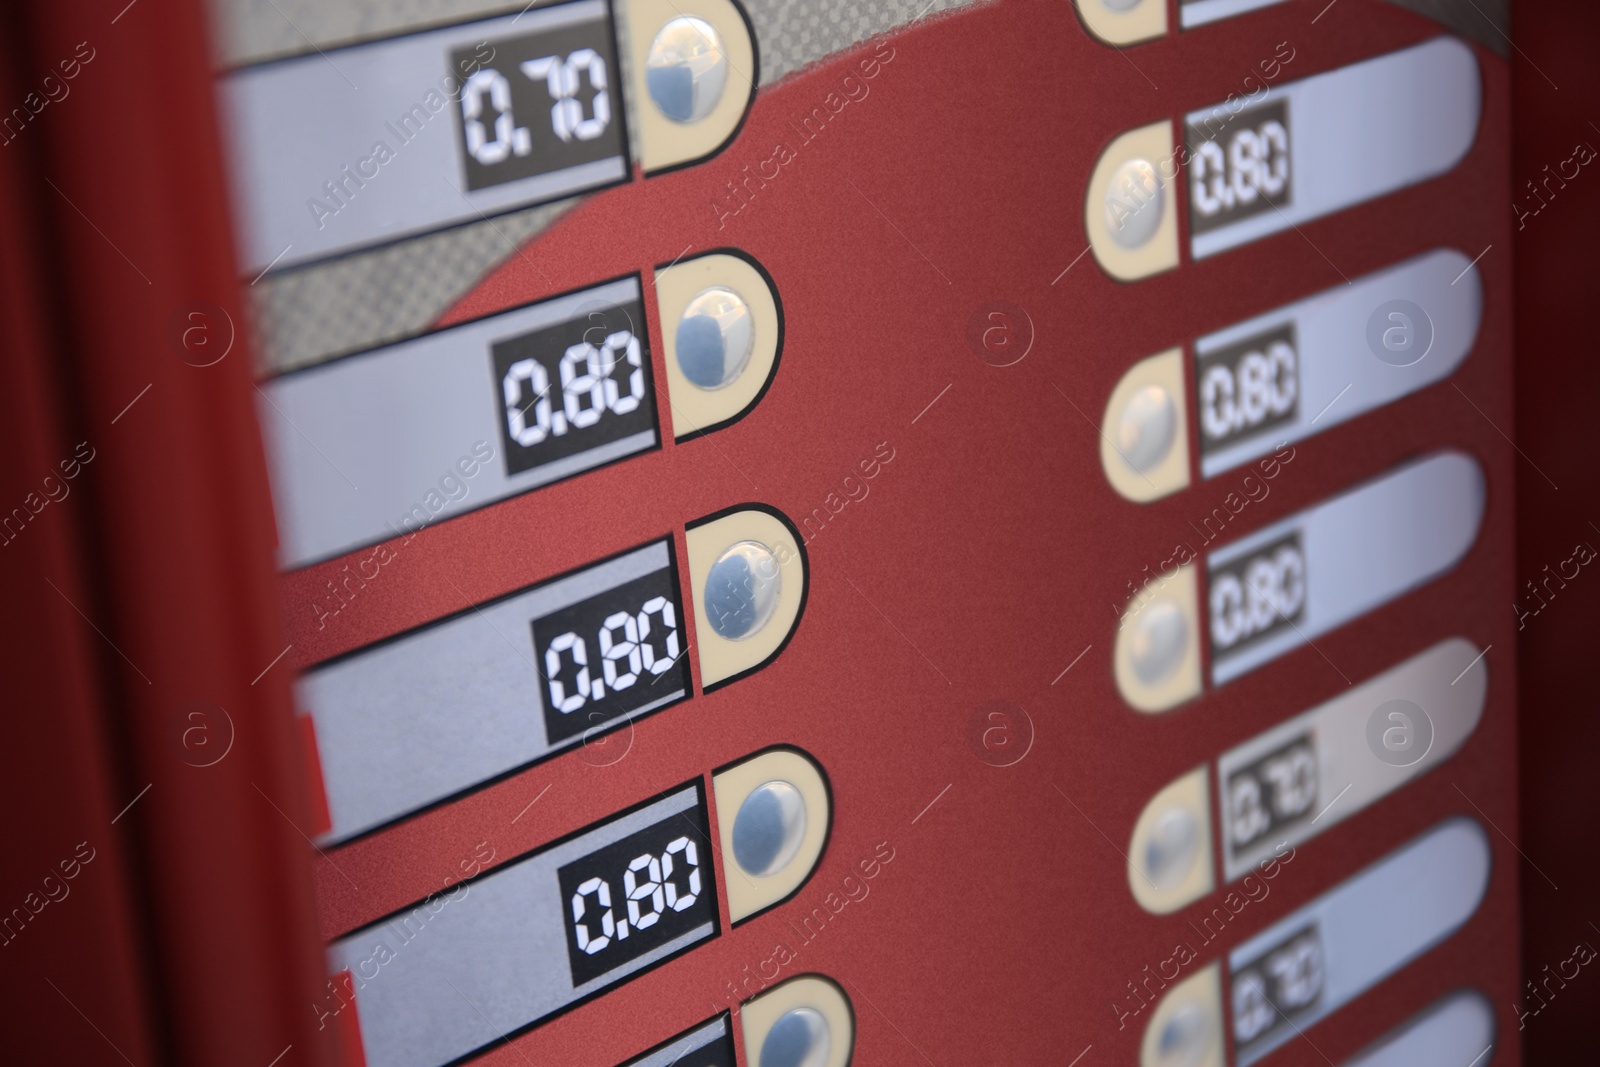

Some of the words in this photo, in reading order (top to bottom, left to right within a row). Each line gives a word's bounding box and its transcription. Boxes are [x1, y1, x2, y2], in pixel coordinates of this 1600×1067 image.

[461, 48, 611, 165] 0.70
[1190, 120, 1289, 215] 0.80
[502, 330, 645, 447] 0.80
[1199, 340, 1298, 439] 0.80
[1210, 546, 1303, 646] 0.80
[545, 595, 680, 714] 0.80
[1231, 751, 1315, 843] 0.70
[571, 836, 702, 955] 0.80
[1232, 943, 1321, 1040] 0.70
